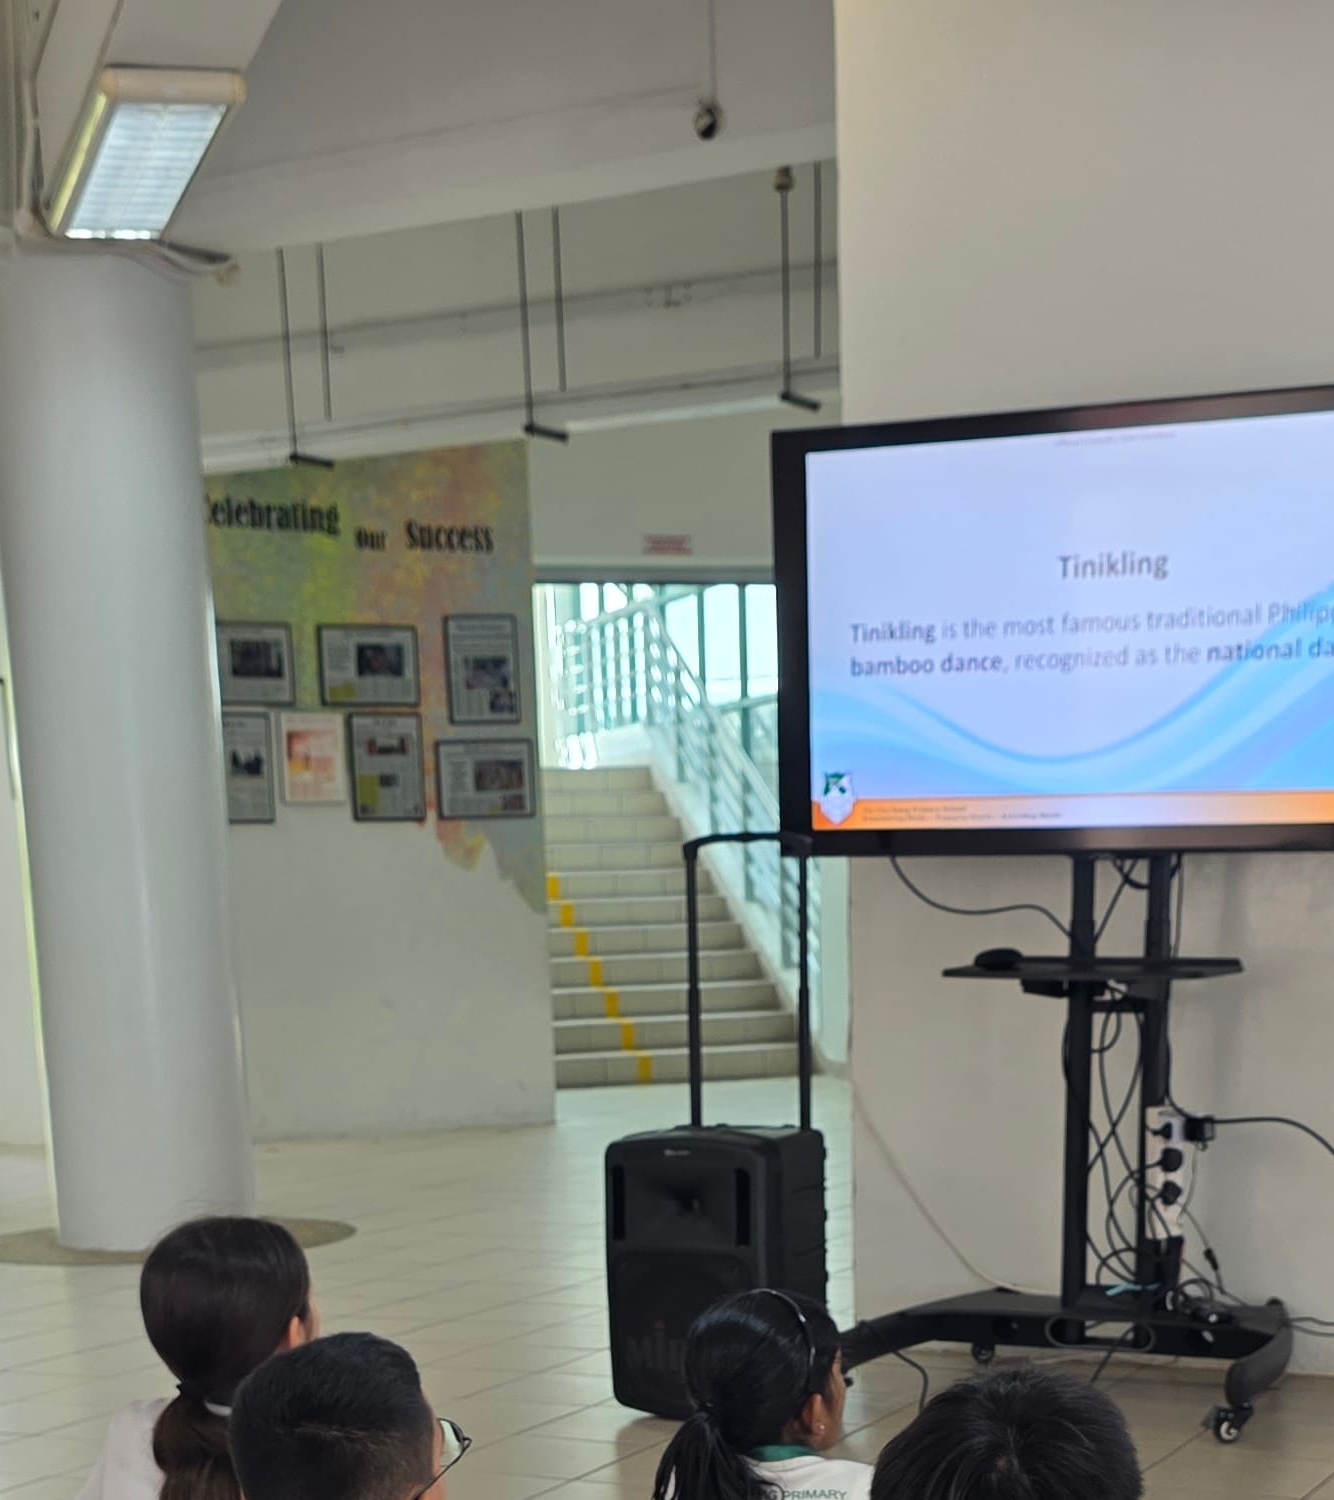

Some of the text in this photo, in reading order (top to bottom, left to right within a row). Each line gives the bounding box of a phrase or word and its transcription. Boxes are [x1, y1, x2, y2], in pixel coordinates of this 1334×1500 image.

[206, 494, 495, 553] elebrating Our Success
[1058, 551, 1169, 580] Tinikling
[850, 621, 936, 644] Tinikling
[942, 619, 957, 639] is
[963, 618, 997, 639] the
[1003, 615, 1055, 636] most
[1062, 611, 1141, 634] famous
[1147, 602, 1262, 630] traditional
[850, 655, 935, 677] bamboo
[1015, 645, 1129, 673] recognized
[1135, 647, 1159, 666] as
[1165, 643, 1202, 665] the
[1207, 637, 1302, 662] national
